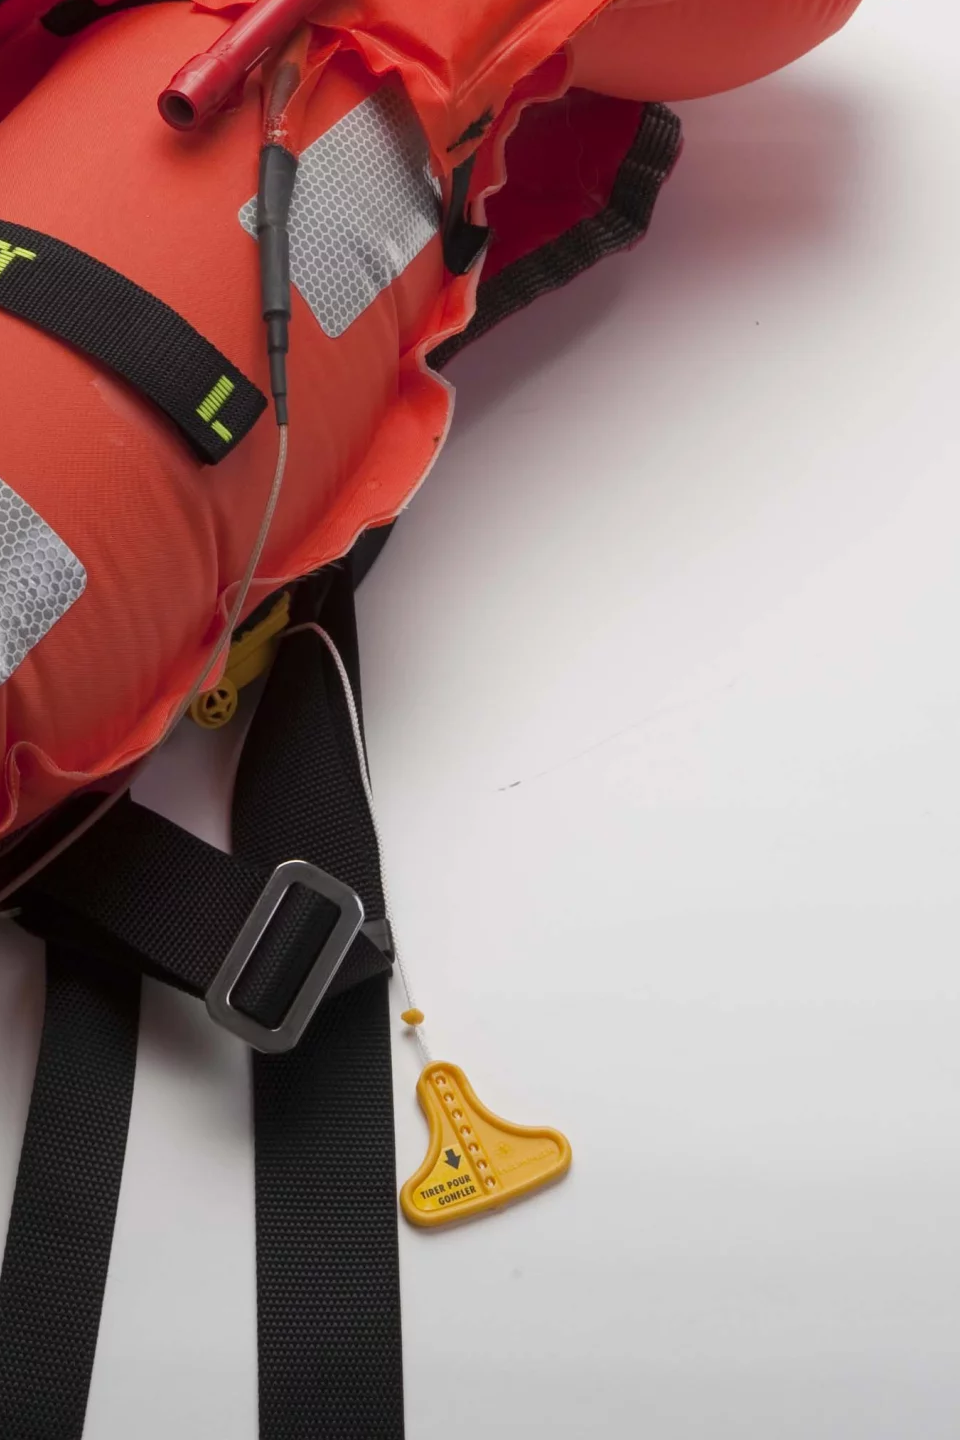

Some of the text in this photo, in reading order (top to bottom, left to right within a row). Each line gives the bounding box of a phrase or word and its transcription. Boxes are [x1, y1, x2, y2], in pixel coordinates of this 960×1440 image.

[420, 1174, 471, 1200] TIRER POUR
[438, 1185, 476, 1205] GONFLER
